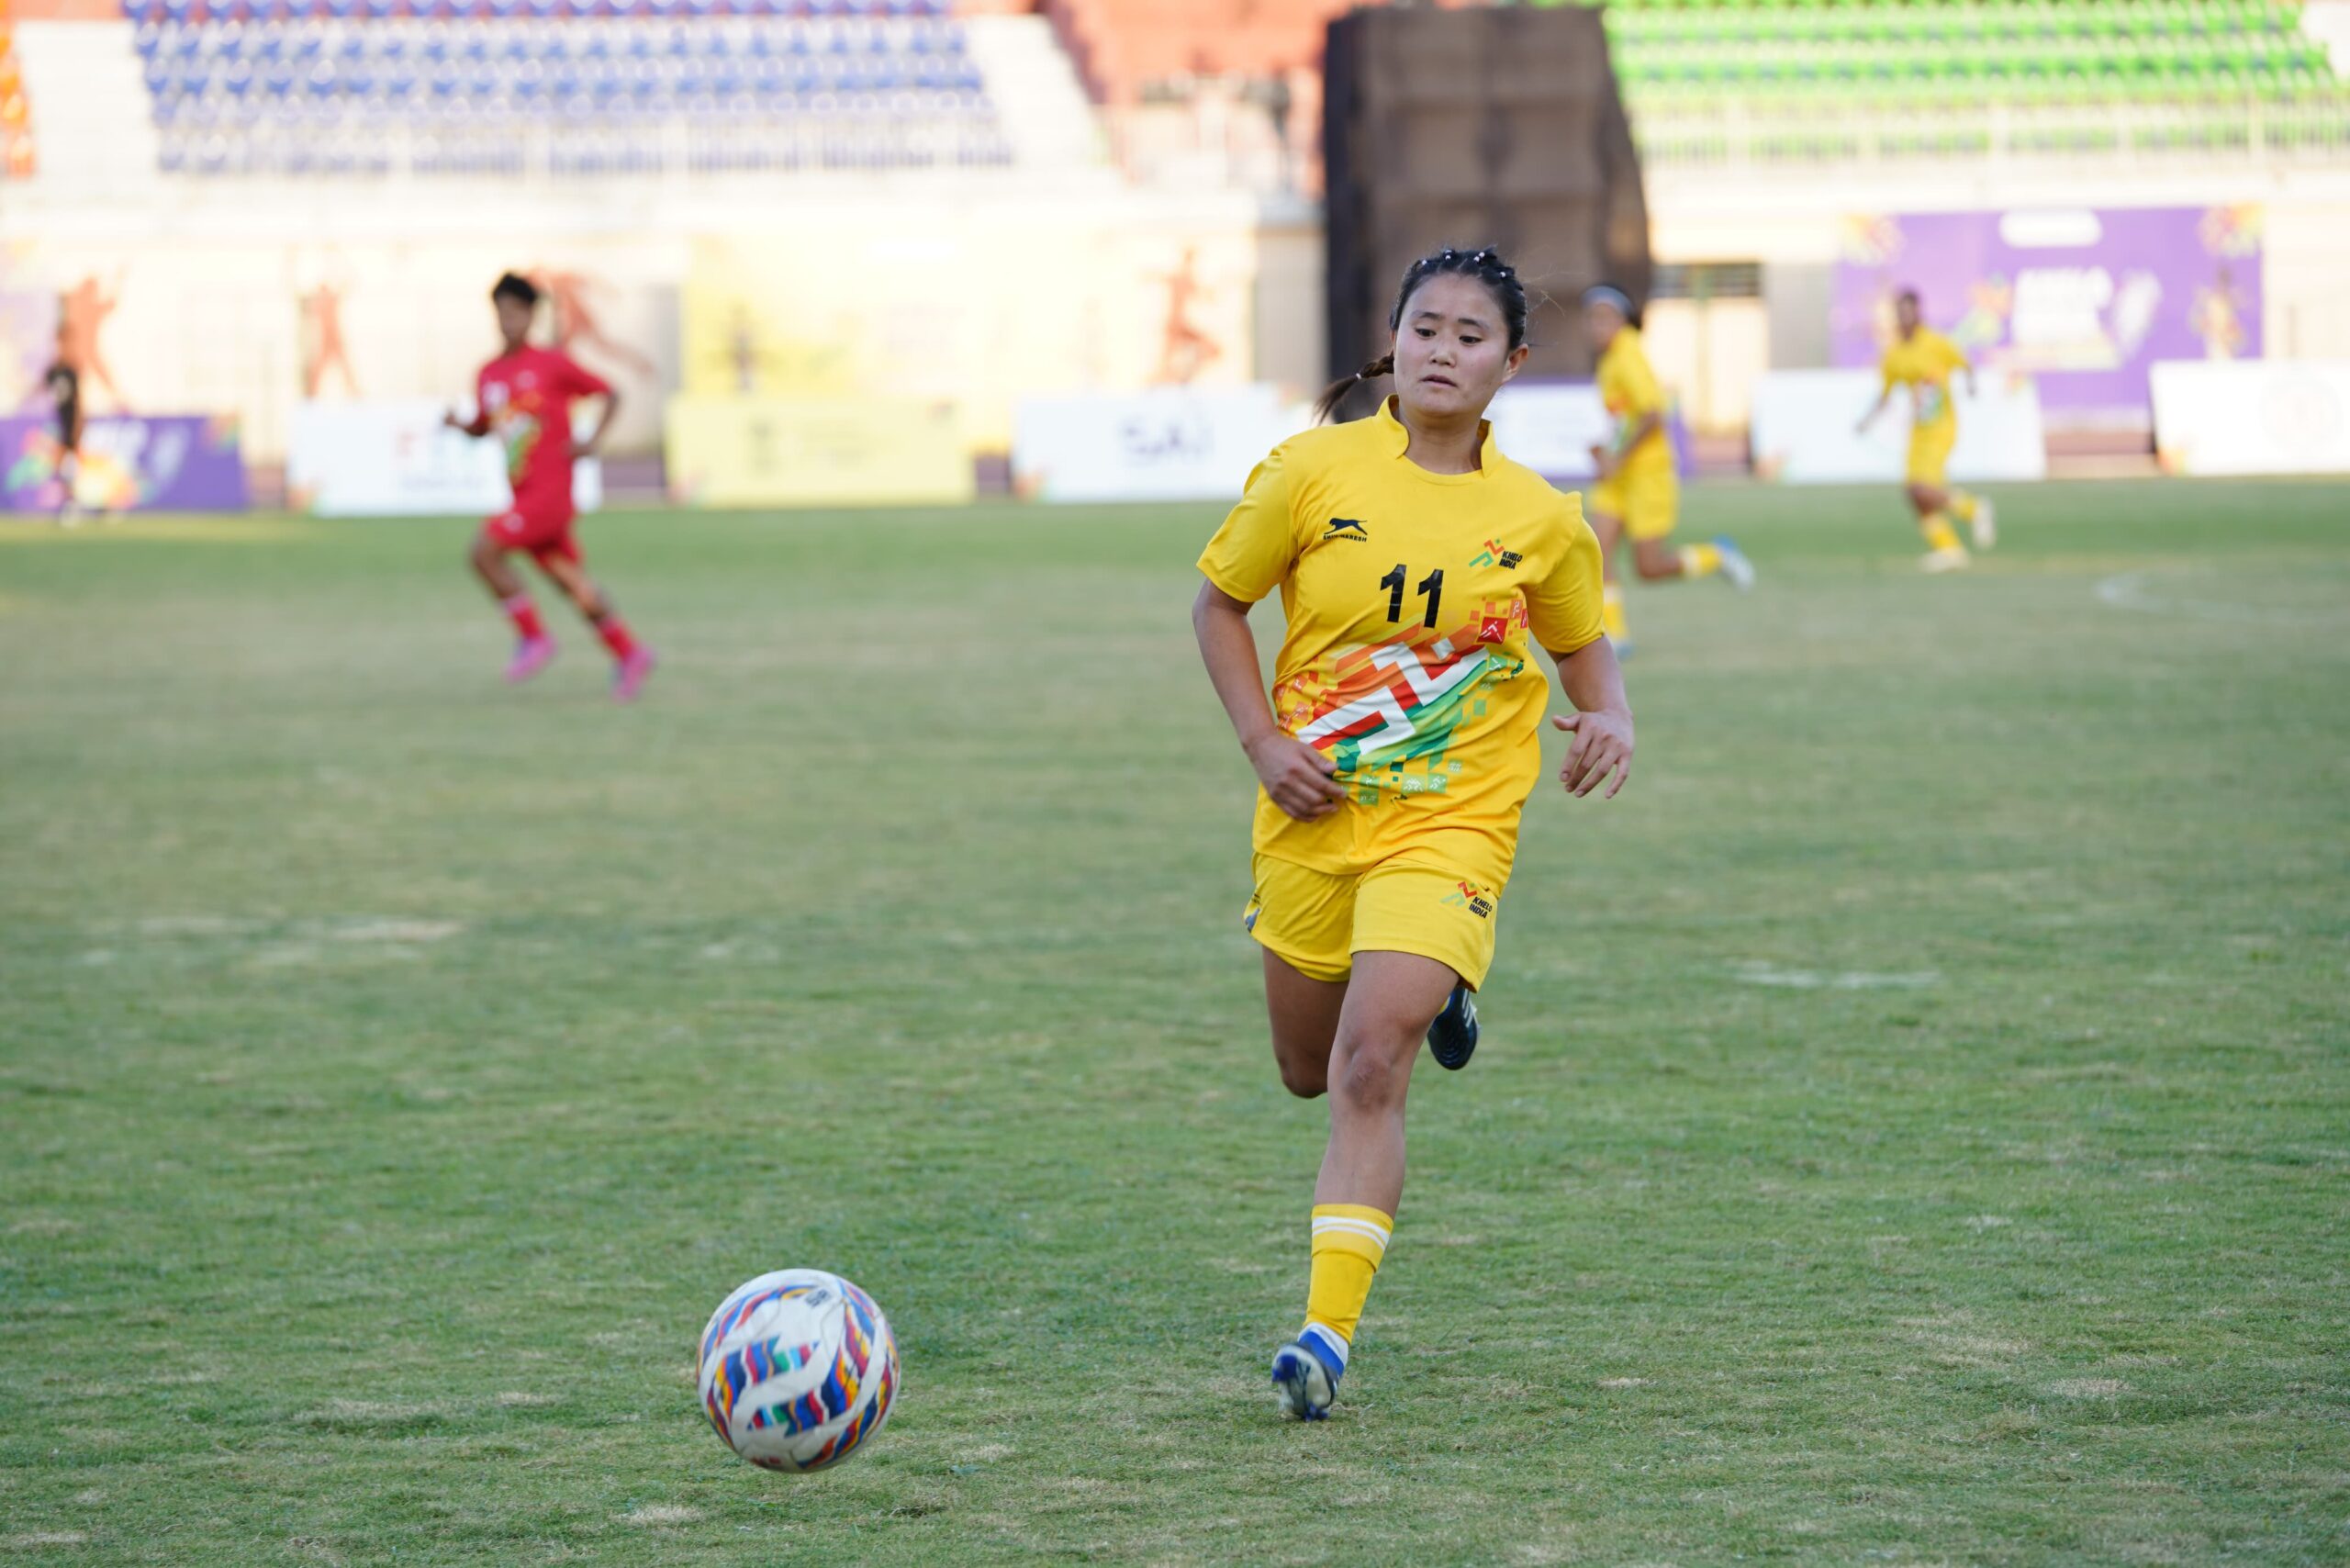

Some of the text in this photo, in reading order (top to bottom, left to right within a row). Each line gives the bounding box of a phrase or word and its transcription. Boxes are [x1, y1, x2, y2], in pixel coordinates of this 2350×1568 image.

[1499, 558, 1516, 569] INDIA
[1380, 564, 1444, 629] 11
[1469, 903, 1487, 918] INDIA
[1472, 896, 1492, 912] KHELO
